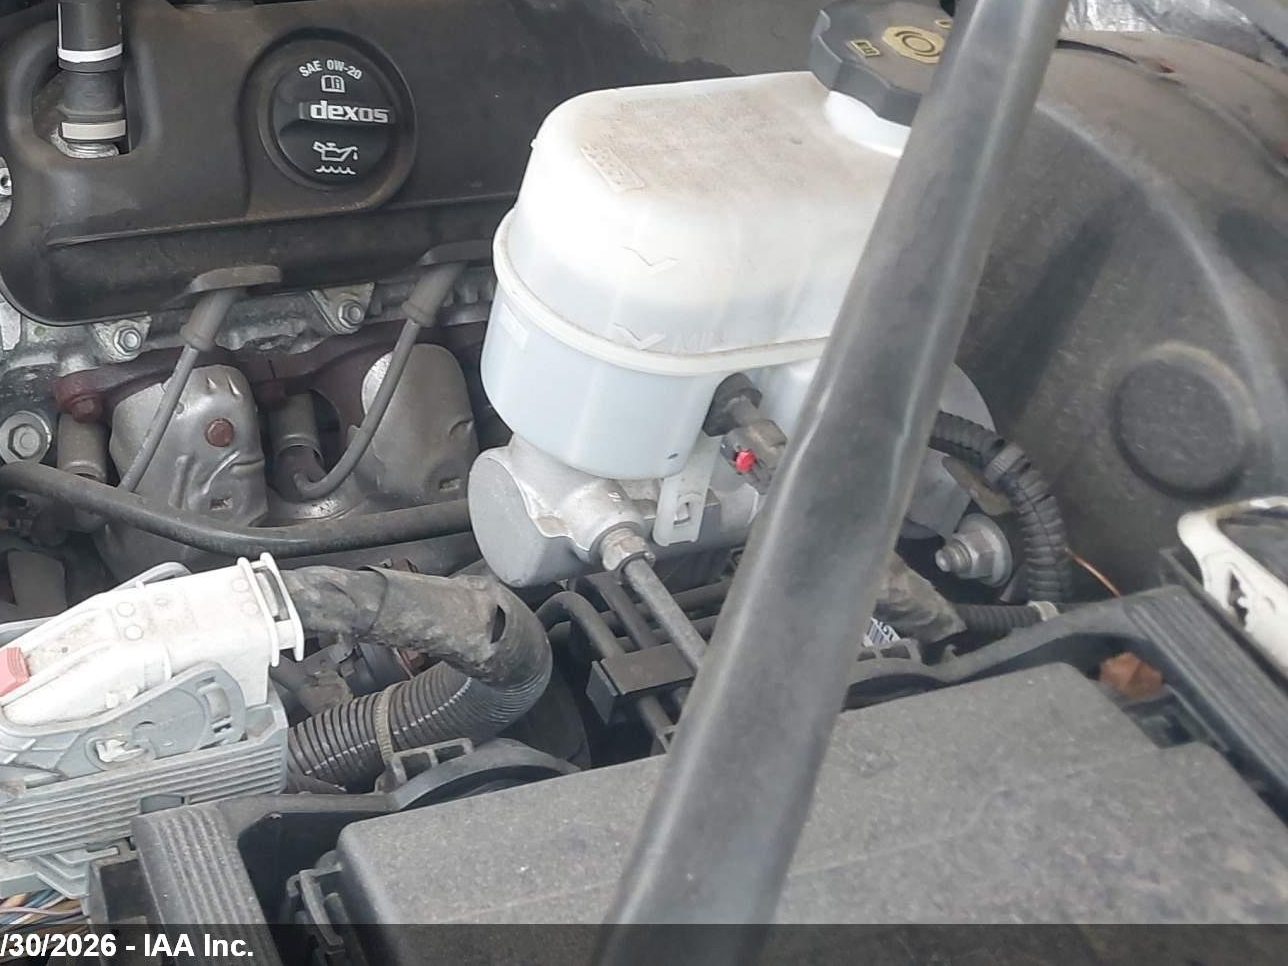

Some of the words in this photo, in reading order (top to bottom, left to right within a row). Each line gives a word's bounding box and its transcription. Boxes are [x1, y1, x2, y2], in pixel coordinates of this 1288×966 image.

[298, 60, 323, 78] SAE
[326, 59, 363, 80] 0W-20
[310, 100, 391, 123] dexos
